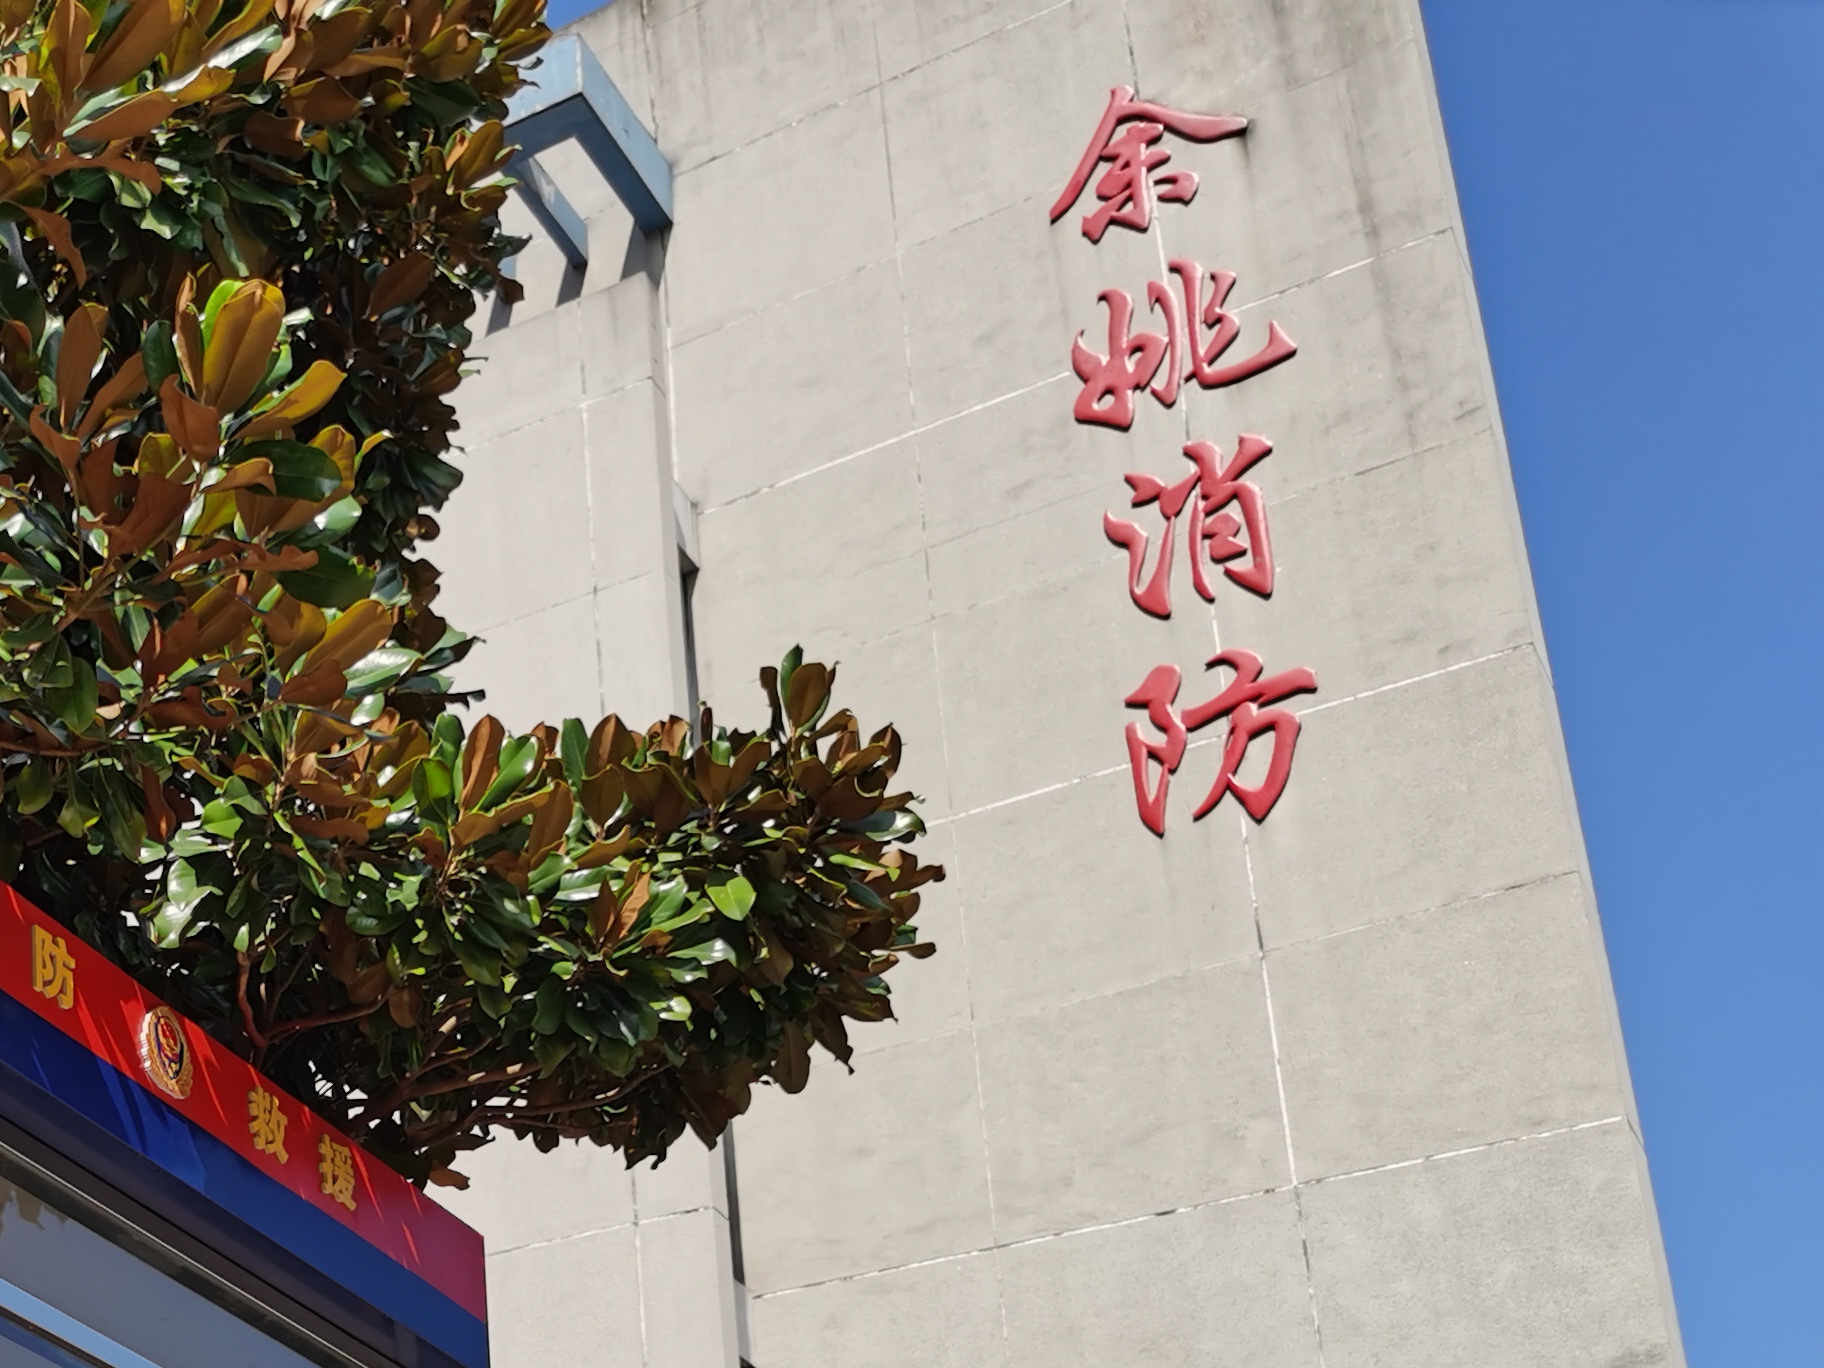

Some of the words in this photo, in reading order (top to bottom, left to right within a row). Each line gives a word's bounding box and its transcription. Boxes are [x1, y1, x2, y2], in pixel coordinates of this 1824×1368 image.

[1048, 84, 1318, 837] 余姚消防
[248, 1086, 357, 1212] 救援
